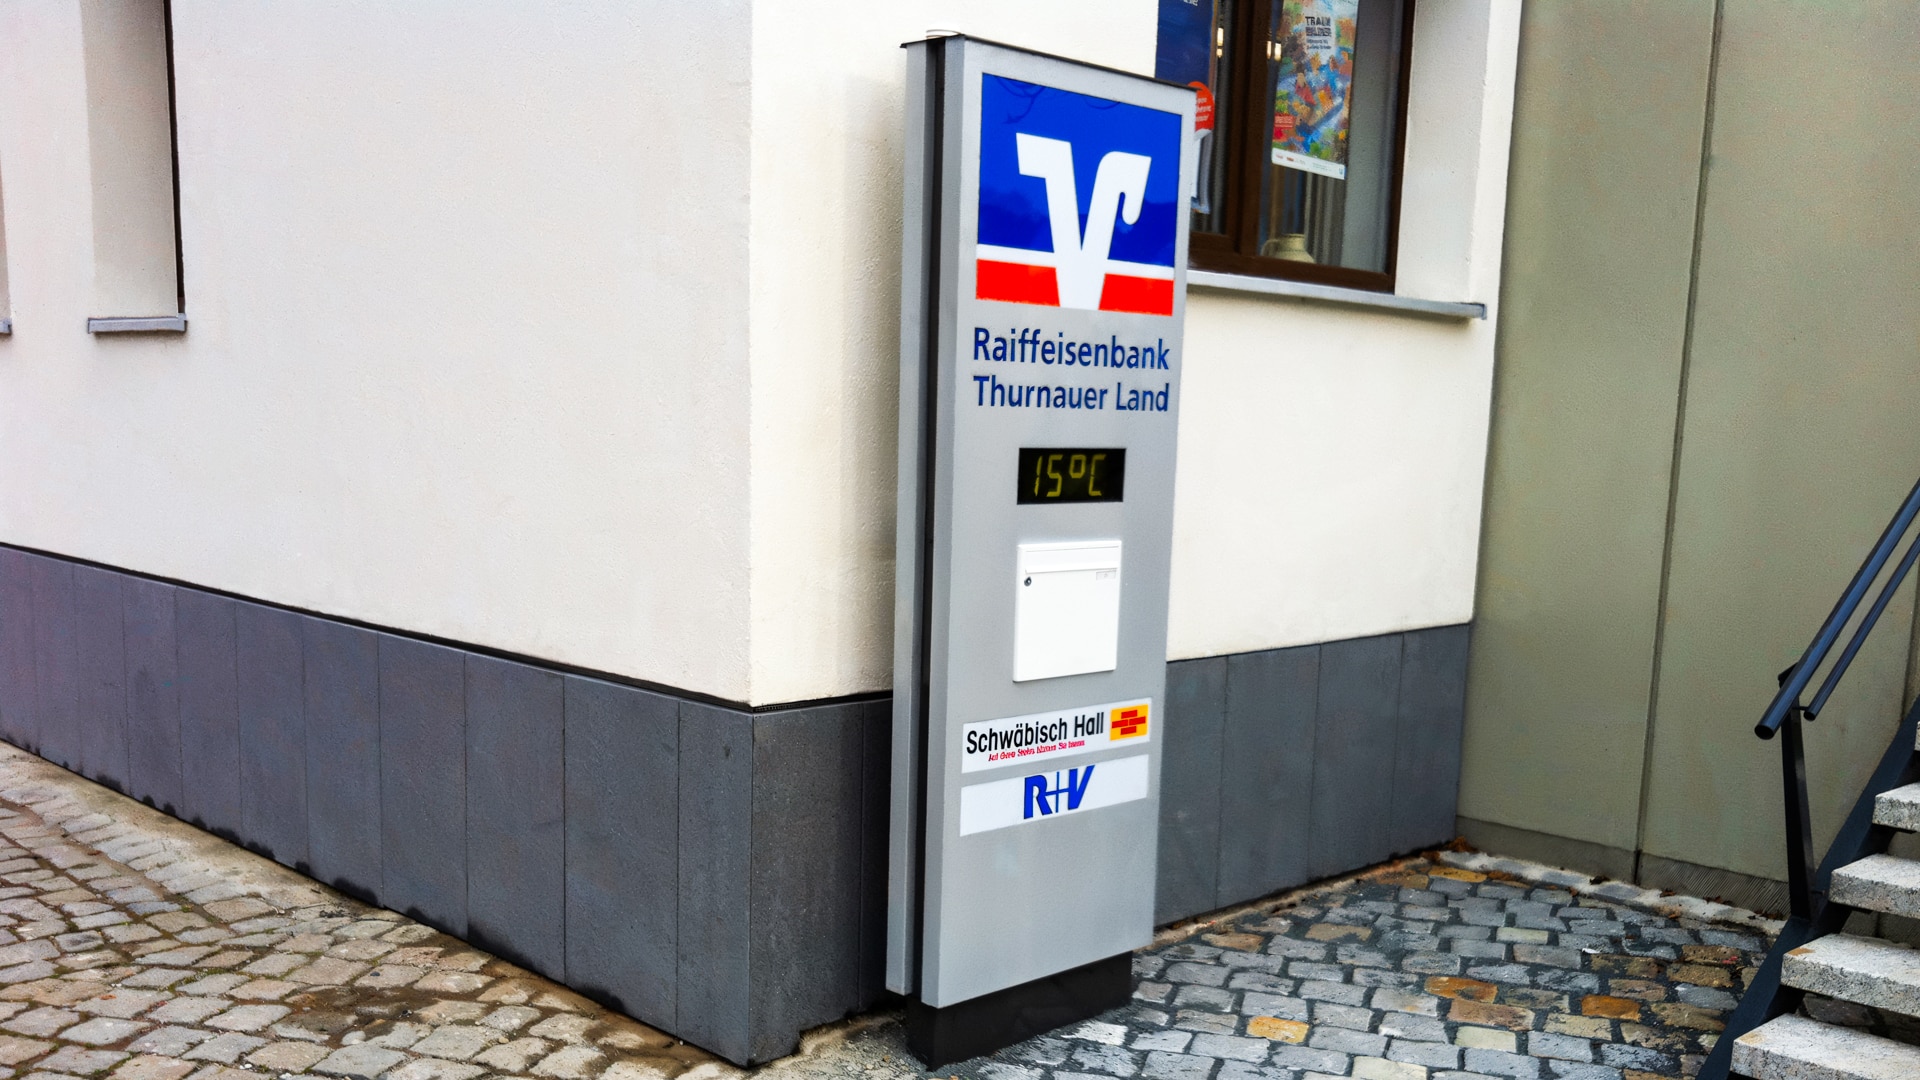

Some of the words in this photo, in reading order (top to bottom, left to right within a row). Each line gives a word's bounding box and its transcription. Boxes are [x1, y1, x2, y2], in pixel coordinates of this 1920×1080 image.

[973, 327, 1170, 370] Raiffeisenbank
[973, 375, 1108, 410] Thurnauer
[1115, 382, 1170, 412] Land
[966, 718, 1068, 754] Schwäbisch
[1073, 711, 1105, 738] Hall
[1023, 764, 1096, 820] R+V
